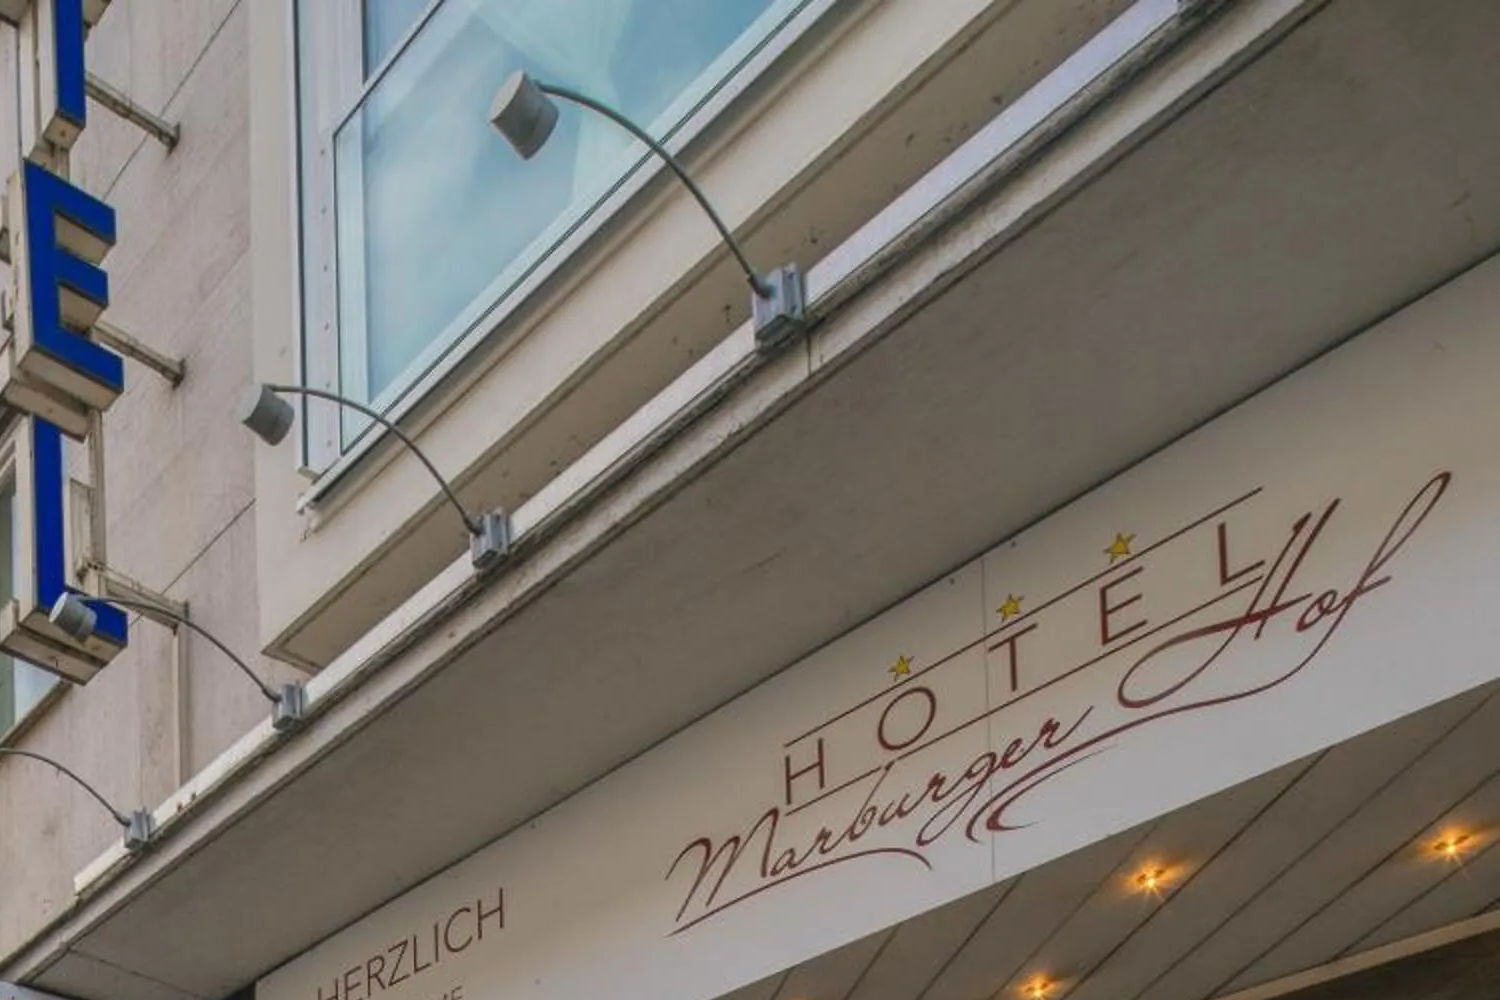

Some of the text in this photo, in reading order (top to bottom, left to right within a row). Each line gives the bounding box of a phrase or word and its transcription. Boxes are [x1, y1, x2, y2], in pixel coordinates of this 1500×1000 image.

[666, 470, 1453, 936] Marburger Hof
[784, 521, 1266, 806] HOTEL
